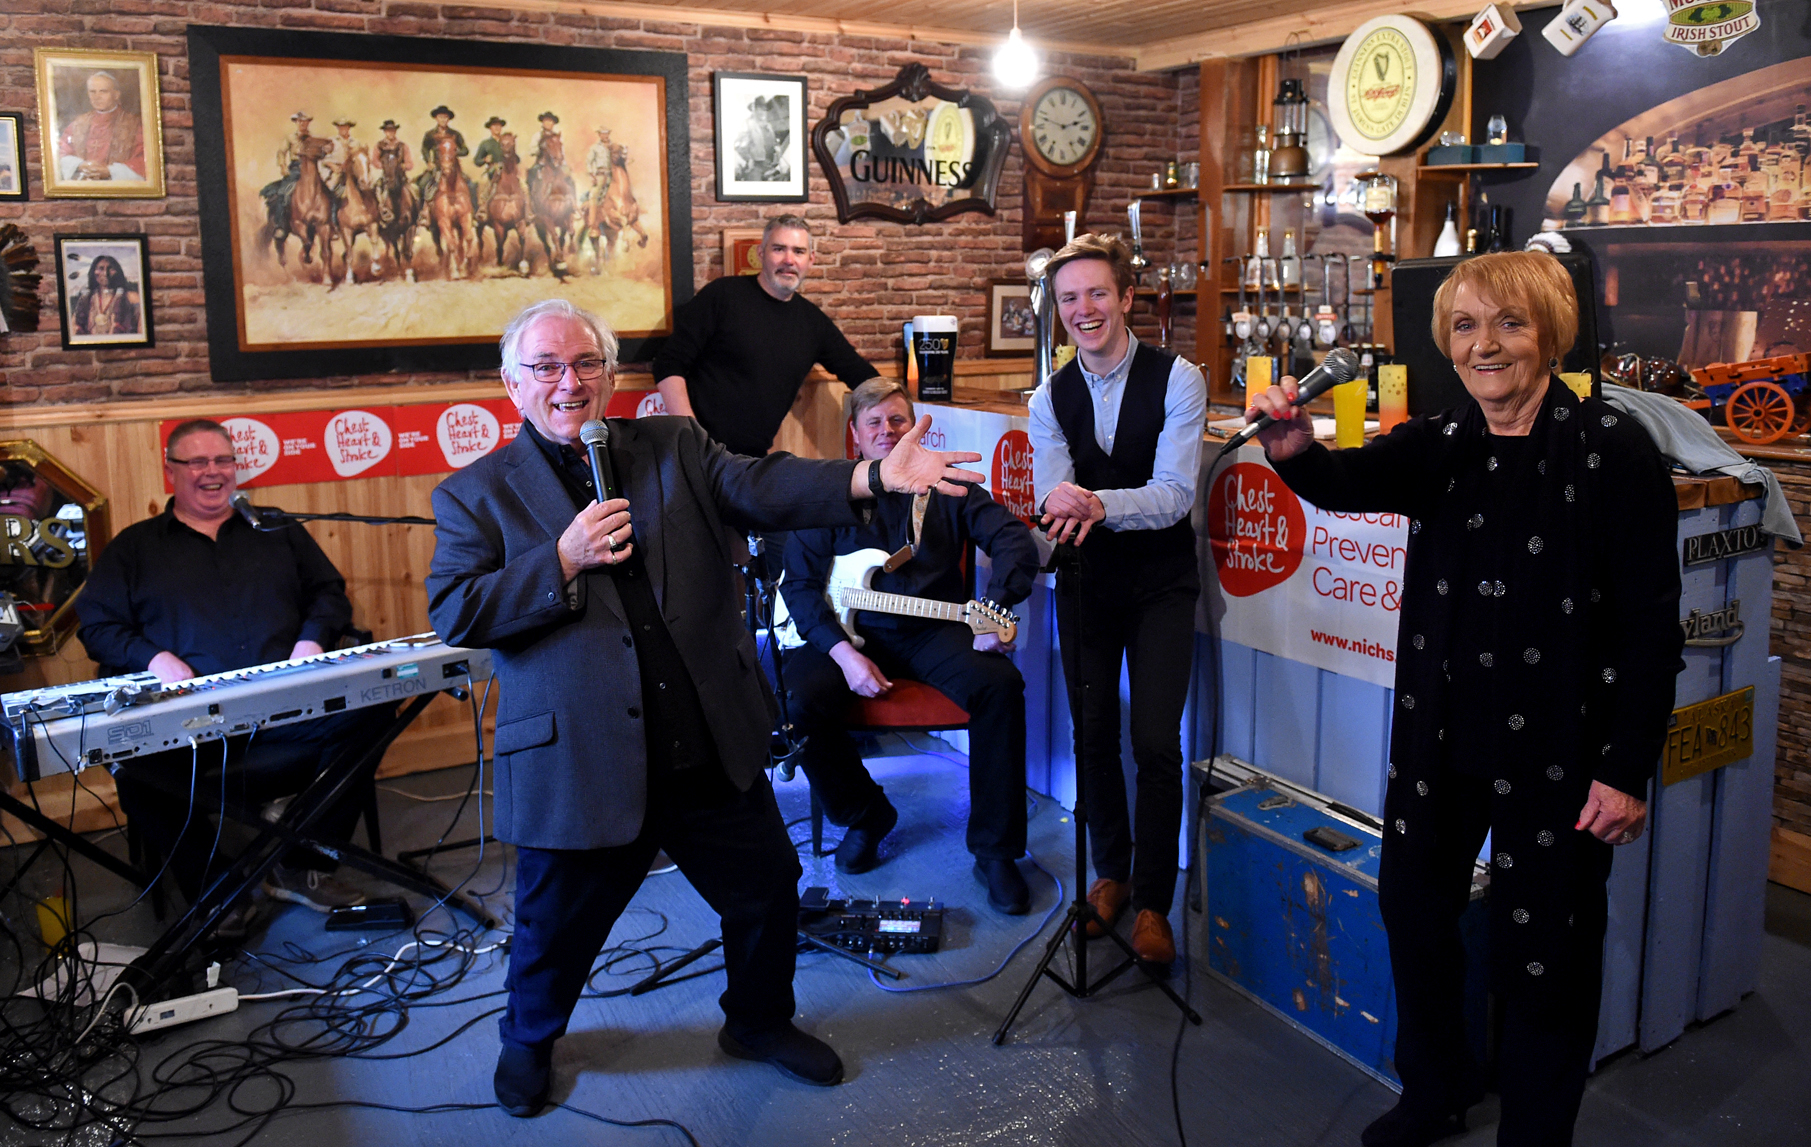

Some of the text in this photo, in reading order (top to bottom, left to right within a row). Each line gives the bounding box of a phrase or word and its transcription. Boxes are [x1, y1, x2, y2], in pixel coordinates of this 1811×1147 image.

[1671, 16, 1750, 41] IRISH STOUT
[851, 150, 977, 188] GUINNESS
[919, 338, 941, 350] 250
[334, 418, 370, 434] Chest
[446, 411, 479, 428] Chest
[225, 424, 256, 443] hest
[336, 431, 382, 448] Heart &
[448, 424, 490, 441] Heart &
[259, 440, 269, 455] &
[339, 449, 379, 463] Stroke
[451, 440, 488, 455] Stroke
[1001, 439, 1034, 470] Chest
[1001, 465, 1034, 495] Heart
[1225, 474, 1275, 513] Chest
[1225, 506, 1289, 552] Heart &
[1226, 538, 1285, 573] Stroke
[1312, 526, 1406, 570] Preven
[1688, 526, 1763, 560] PLAXTO
[1312, 566, 1401, 611] Care &
[360, 678, 427, 702] KETRON
[1667, 721, 1702, 768] FEA
[1719, 705, 1751, 748] 843
